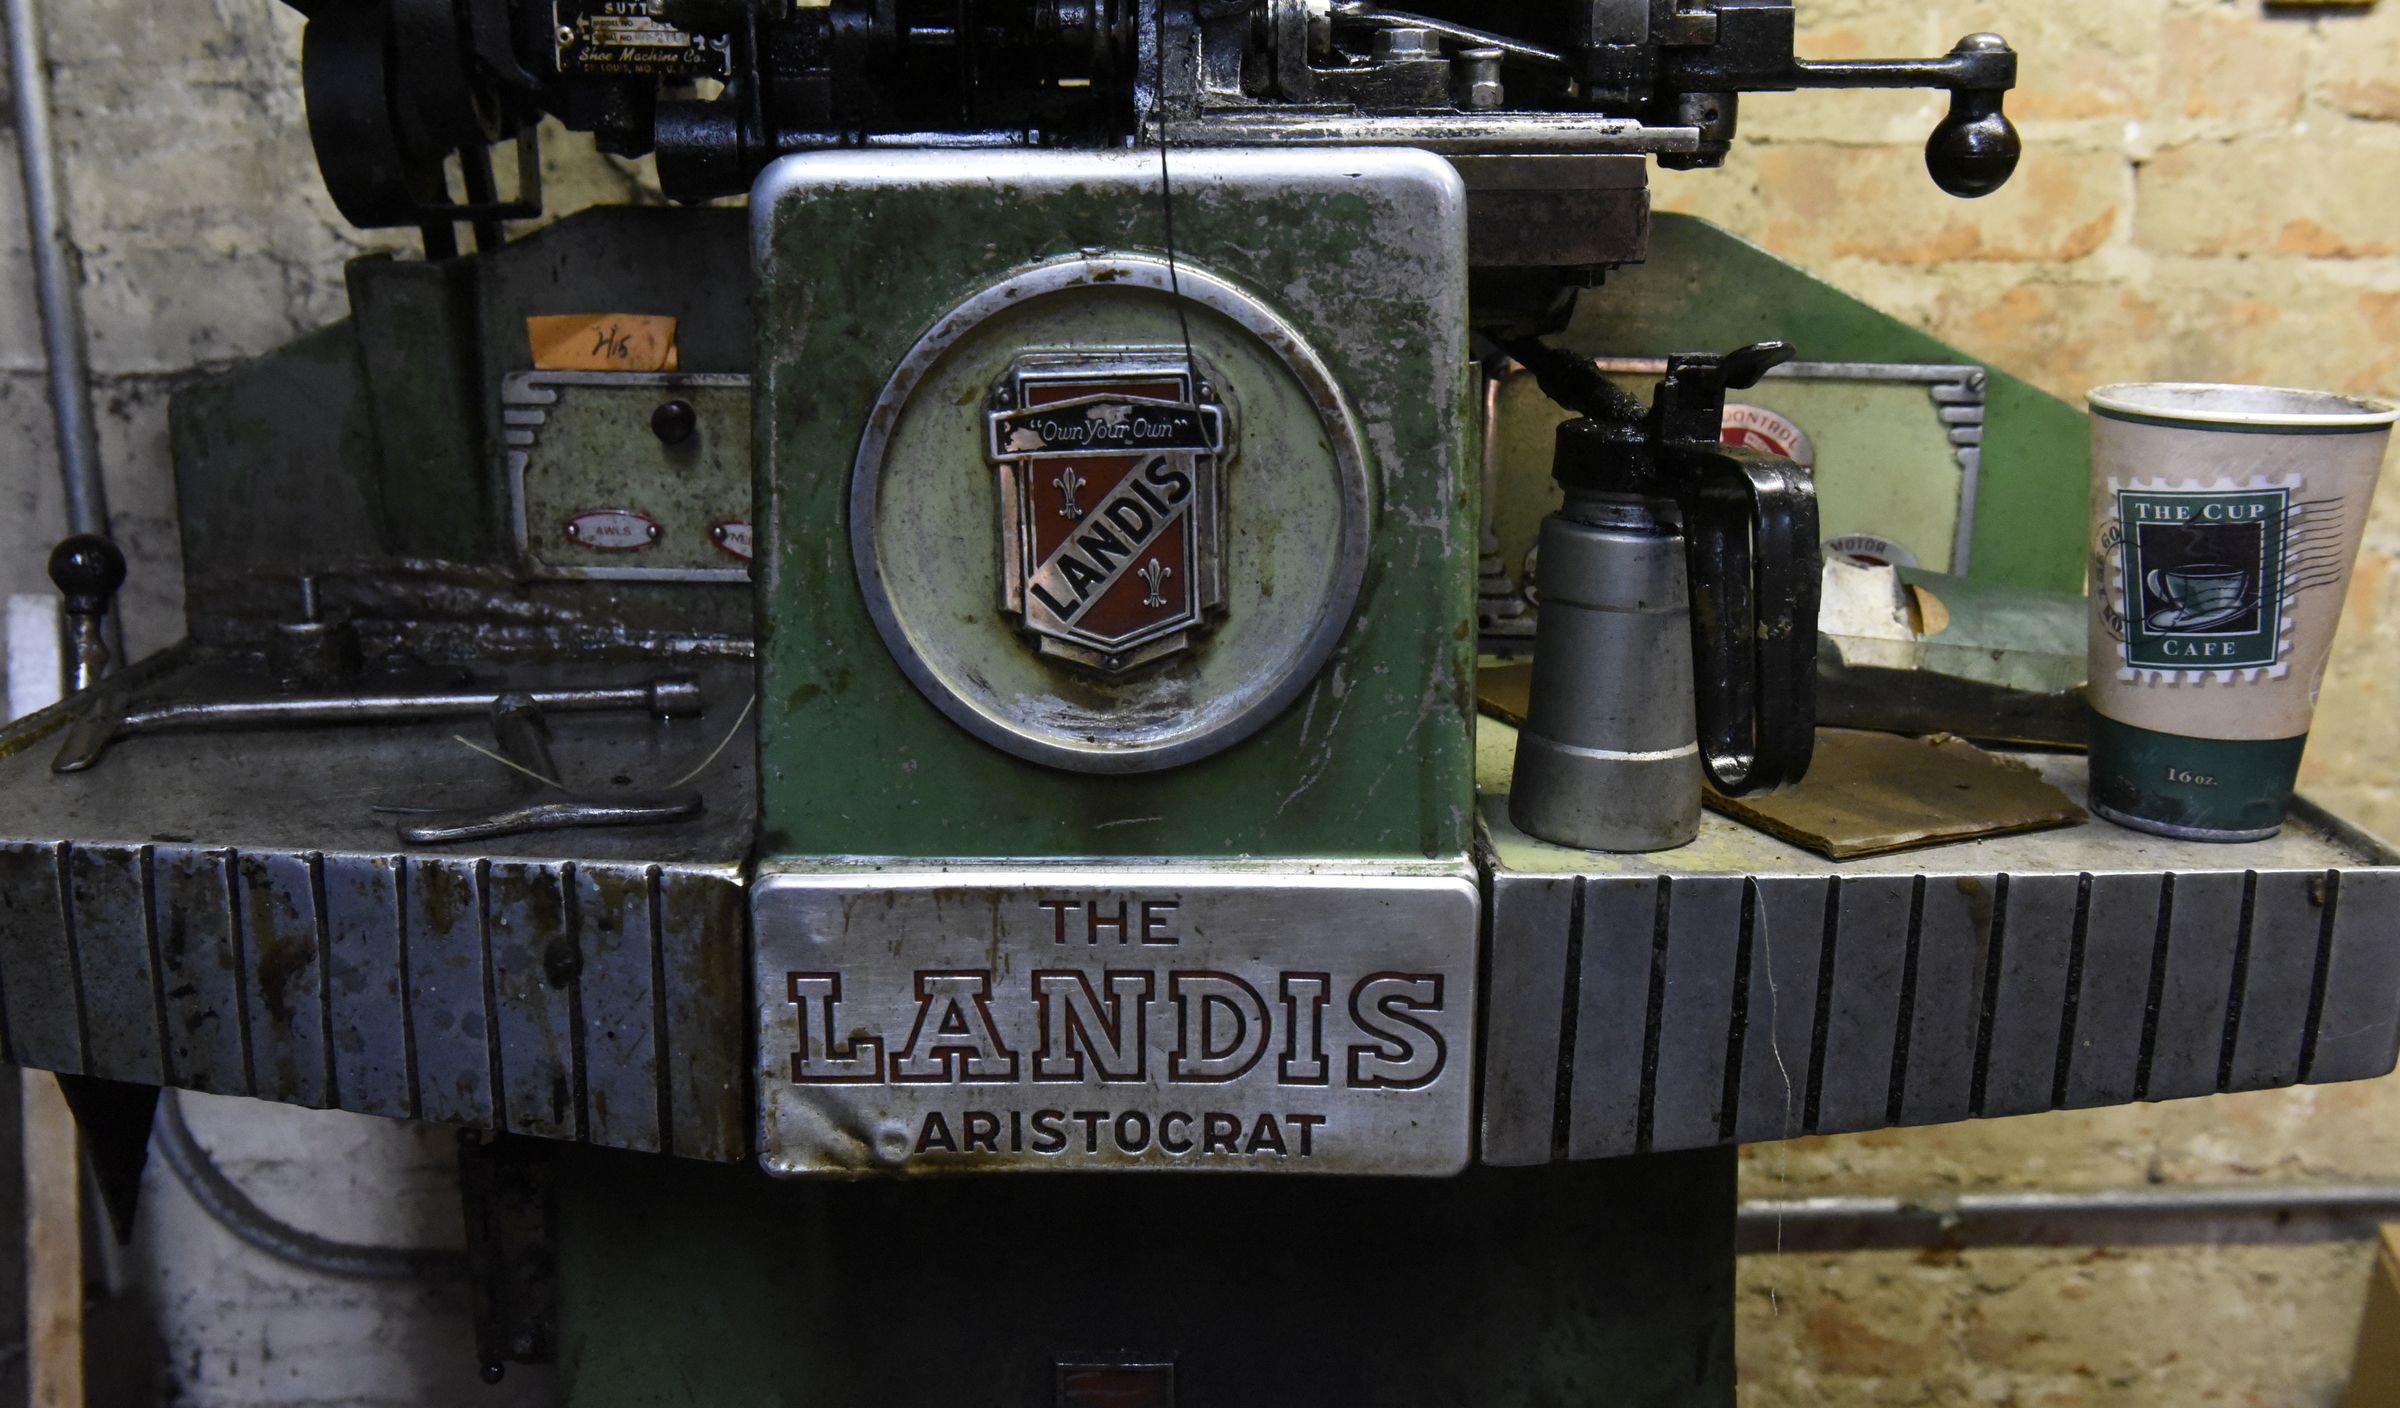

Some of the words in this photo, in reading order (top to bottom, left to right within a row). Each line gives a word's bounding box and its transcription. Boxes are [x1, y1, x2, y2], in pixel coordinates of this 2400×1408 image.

[604, 2, 648, 15] SUTT
[578, 46, 613, 62] Shoe
[619, 47, 679, 62] Machine
[683, 48, 706, 63] Co.
[1082, 418, 1130, 445] Your
[2135, 503, 2191, 520] THE
[2203, 503, 2265, 520] CUP
[596, 526, 632, 536] AWLS
[1029, 455, 1192, 623] LANDIS
[1830, 537, 1887, 554] MOTOR
[2162, 639, 2236, 656] CAFE
[1039, 901, 1179, 945] THE
[786, 969, 1448, 1090] LANDIS
[914, 1110, 1326, 1157] ARISTOCRAT
